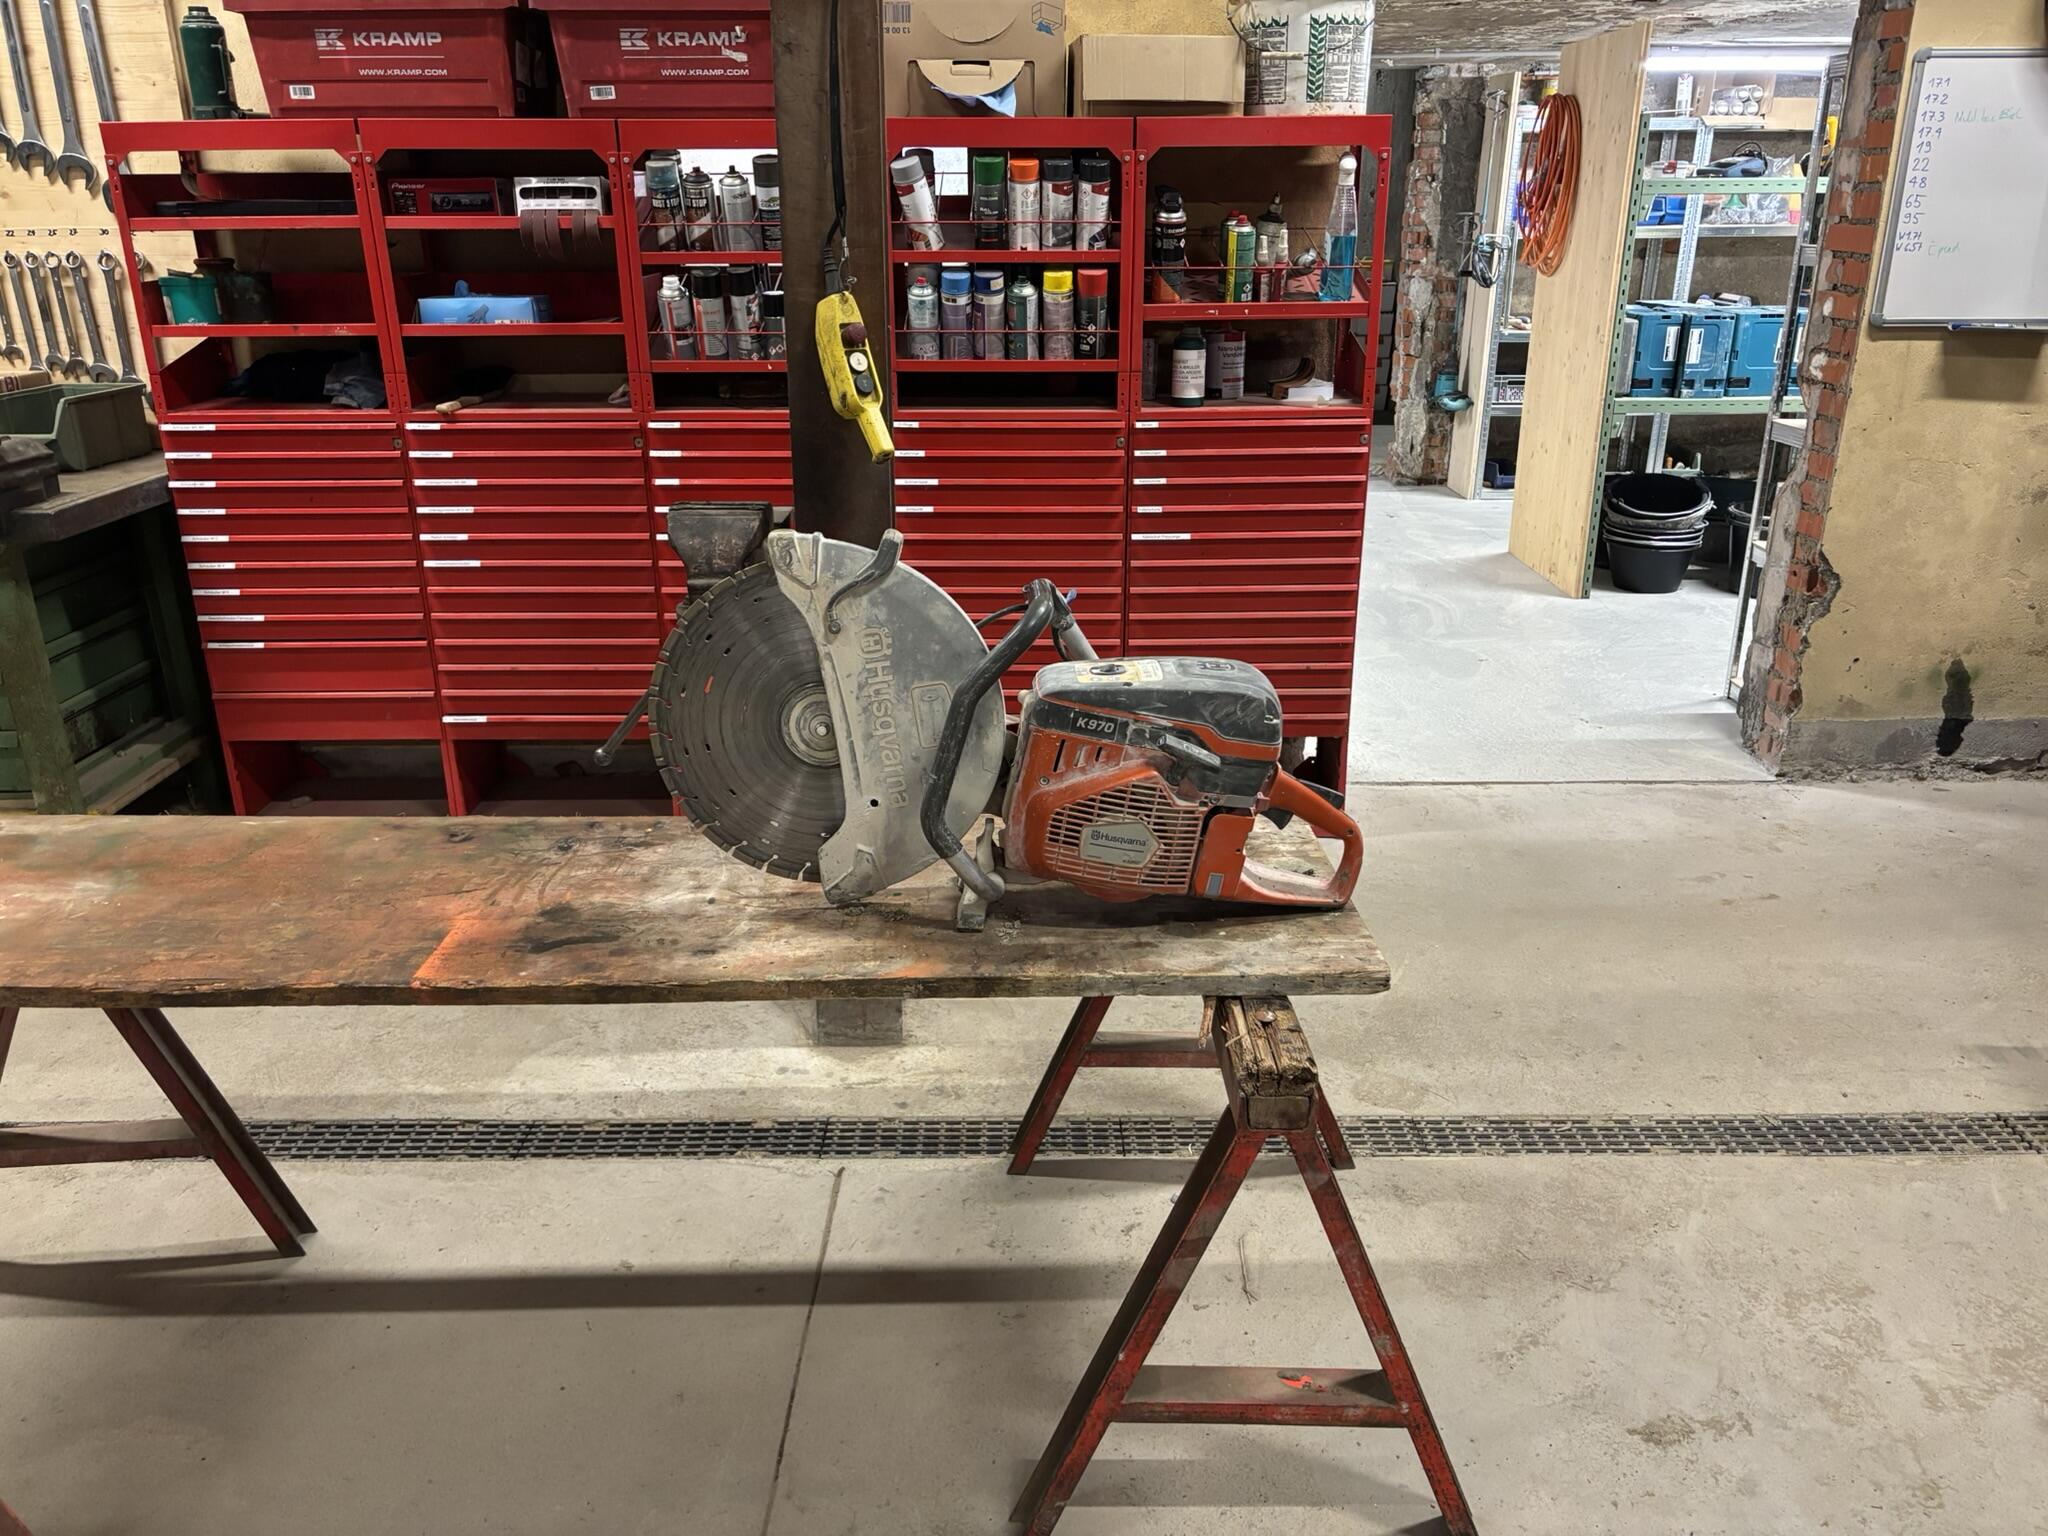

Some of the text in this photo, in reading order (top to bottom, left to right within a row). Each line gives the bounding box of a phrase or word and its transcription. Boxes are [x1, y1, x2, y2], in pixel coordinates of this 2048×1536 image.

[353, 31, 442, 47] KRAMP
[657, 31, 747, 47] KRAMP
[358, 68, 448, 76] WWW.KRAMP.COM
[660, 68, 749, 76] WWW.KRAMP.COM
[1924, 93, 1949, 105] 17.2
[1921, 110, 1946, 122] 17.3
[1916, 140, 1932, 153] 19
[1912, 157, 1930, 172] 22
[391, 182, 425, 190] Pioneer
[1908, 175, 1928, 189] 48
[1905, 193, 1928, 209] 65
[1902, 211, 1927, 225] 95
[1076, 717, 1114, 733] K970
[864, 657, 909, 809] Husqvarna
[1100, 832, 1147, 847] Husqvarna
